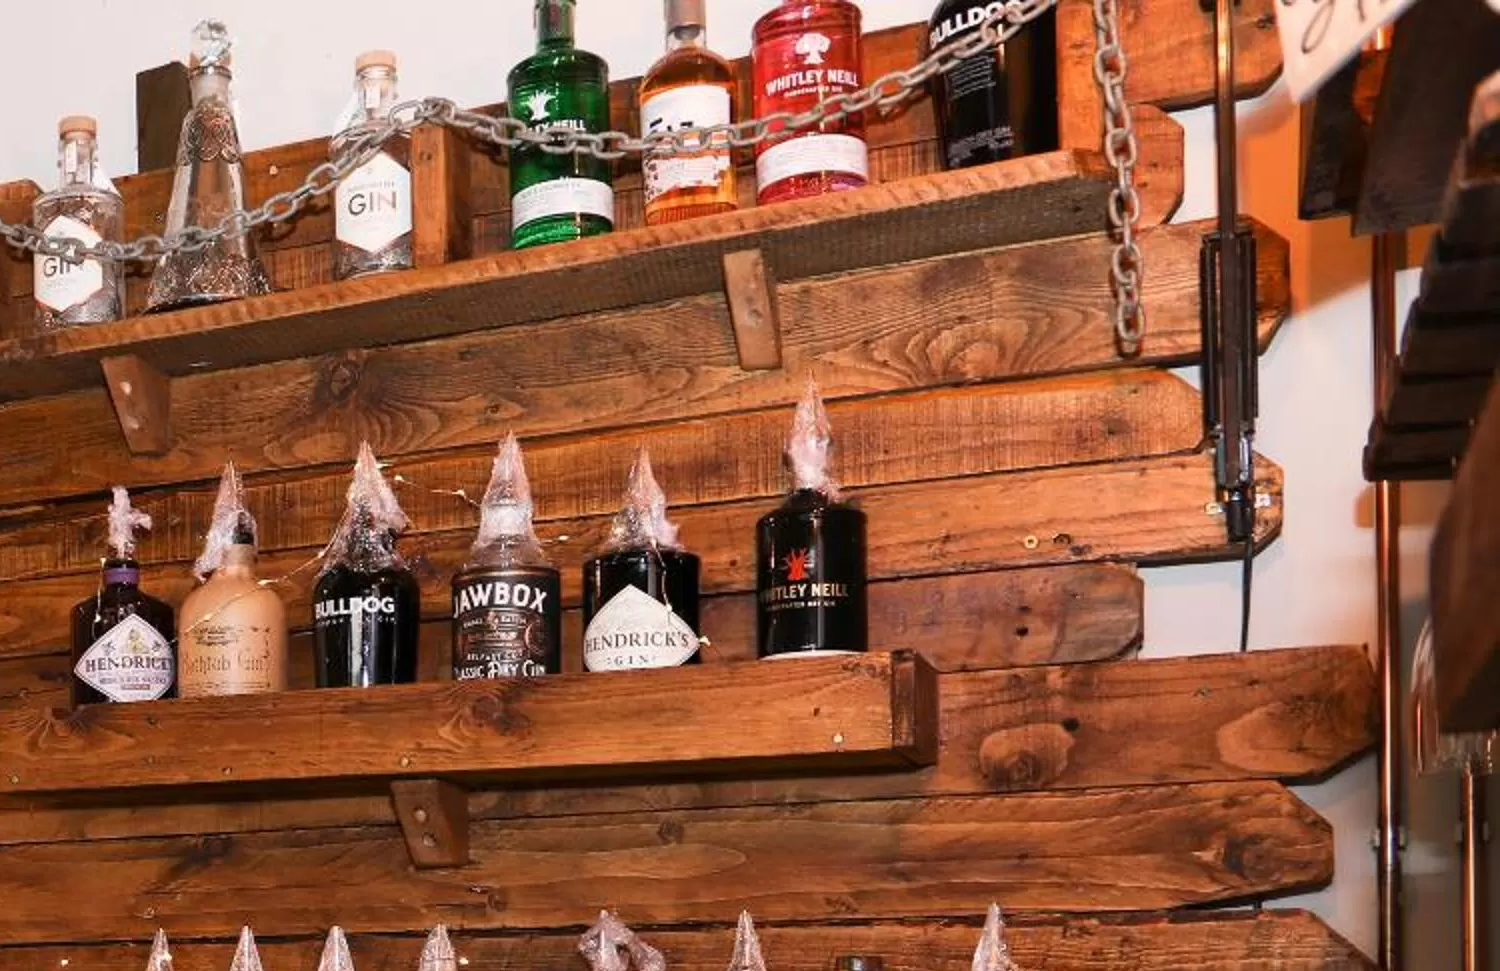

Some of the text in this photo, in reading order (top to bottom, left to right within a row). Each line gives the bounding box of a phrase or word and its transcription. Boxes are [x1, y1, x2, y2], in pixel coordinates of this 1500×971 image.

[765, 69, 859, 97] WHITLEY NEILL
[347, 190, 397, 217] GIN
[453, 581, 547, 619] JAWBOX
[811, 583, 849, 597] NEILL
[314, 596, 395, 620] BULLDOG
[584, 631, 690, 654] HENDRICK'S
